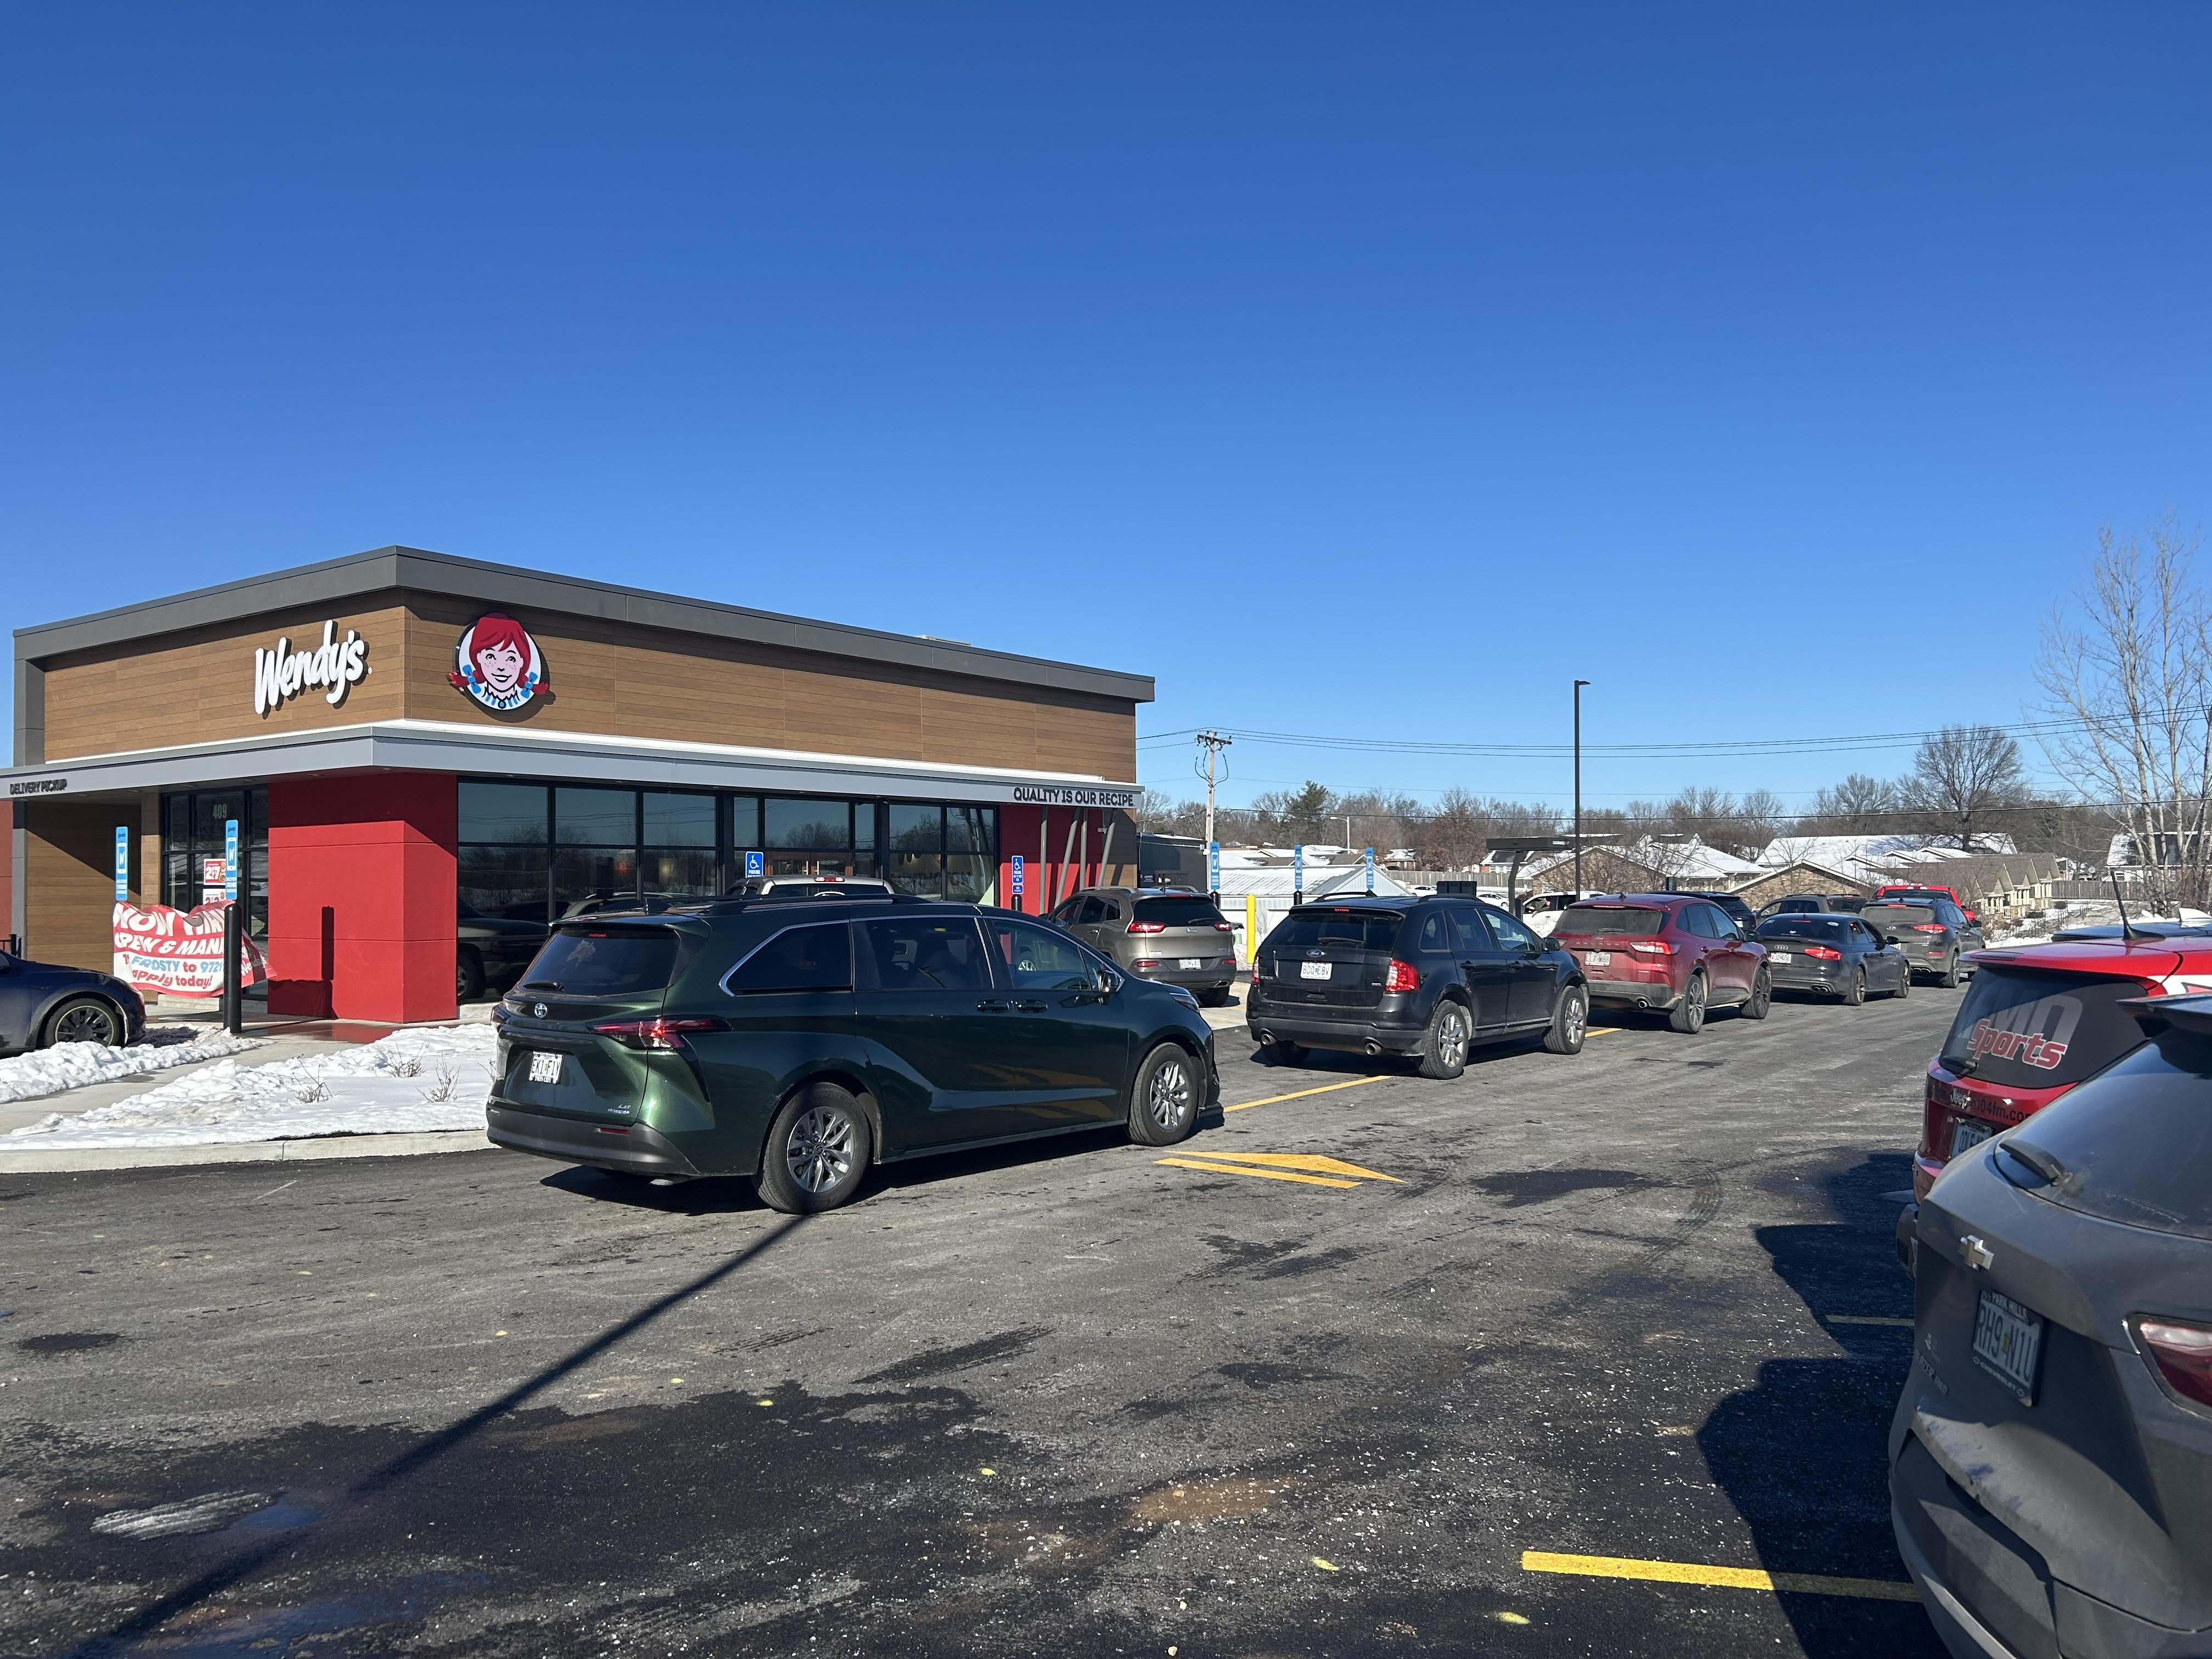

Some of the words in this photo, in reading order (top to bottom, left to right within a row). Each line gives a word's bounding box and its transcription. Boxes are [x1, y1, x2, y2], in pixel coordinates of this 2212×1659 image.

[255, 619, 365, 714] Wendy's
[9, 781, 41, 795] DELIVERY
[41, 778, 68, 793] PICKUP
[1014, 787, 1060, 802] QUALITY
[1062, 790, 1073, 804] IS
[1075, 790, 1097, 805] OUR
[1099, 793, 1133, 806] RECIPE
[212, 804, 228, 820] 409
[113, 905, 176, 936] NOW
[158, 940, 177, 953] &
[131, 956, 180, 973] FROSTY
[183, 961, 197, 973] to
[132, 969, 173, 986] apply
[175, 975, 213, 990] today!
[1966, 1019, 2068, 1070] Sports
[1950, 1088, 1971, 1109] Jeep
[1979, 1362, 2017, 1391] CHEVROLET
